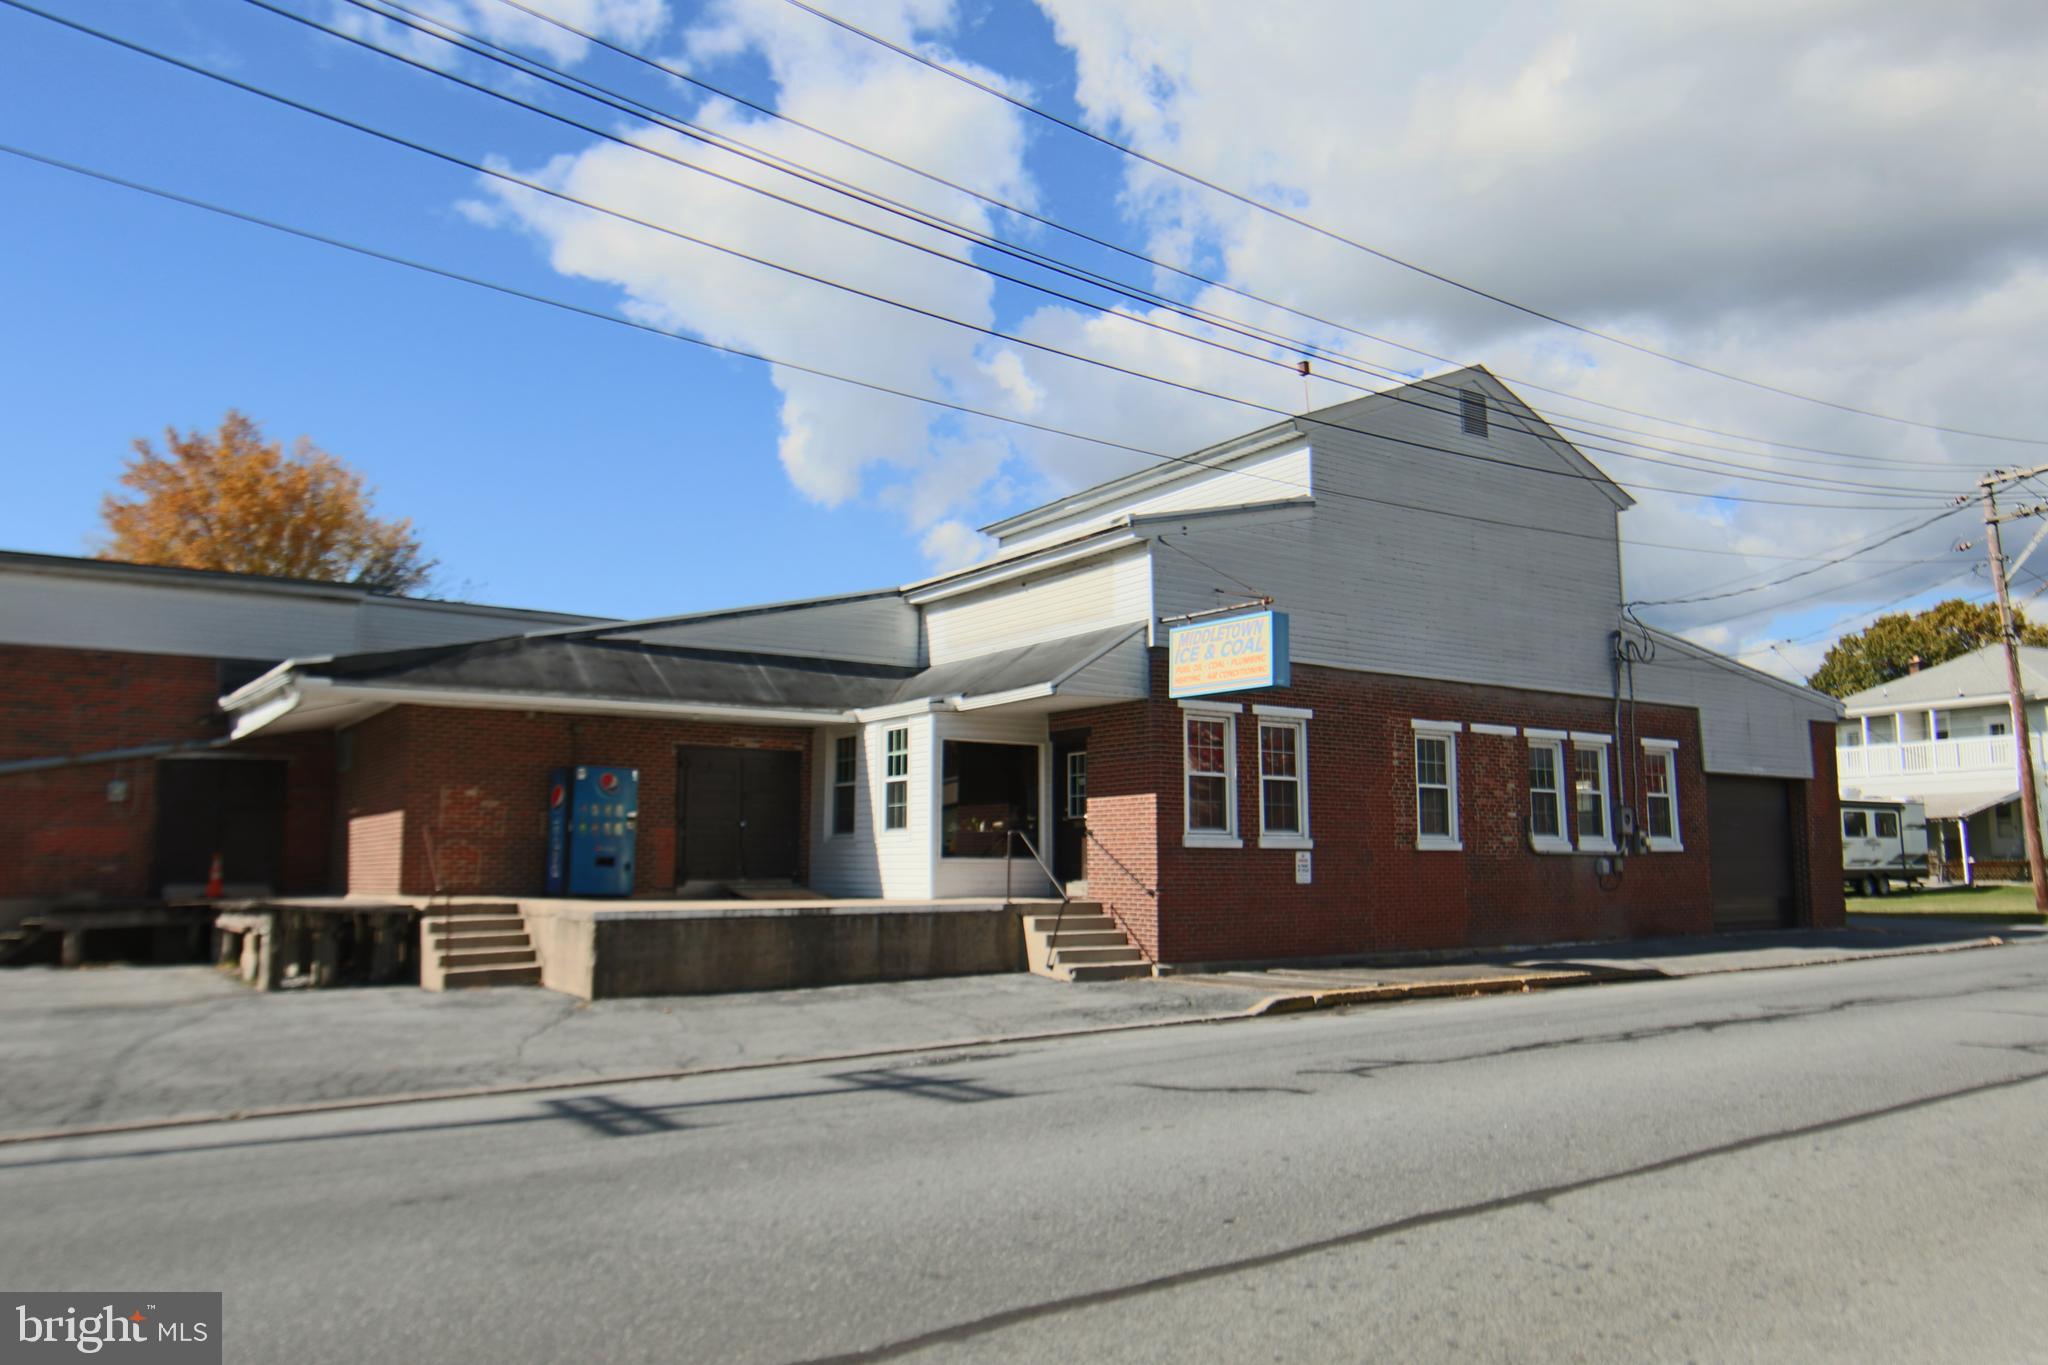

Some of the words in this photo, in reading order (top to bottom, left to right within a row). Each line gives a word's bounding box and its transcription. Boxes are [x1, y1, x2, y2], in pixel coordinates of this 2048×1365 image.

[1178, 620, 1264, 646] MIDDLETOWN
[1175, 645, 1201, 664] ICE
[1205, 644, 1217, 660] &
[1221, 637, 1264, 657] COAL
